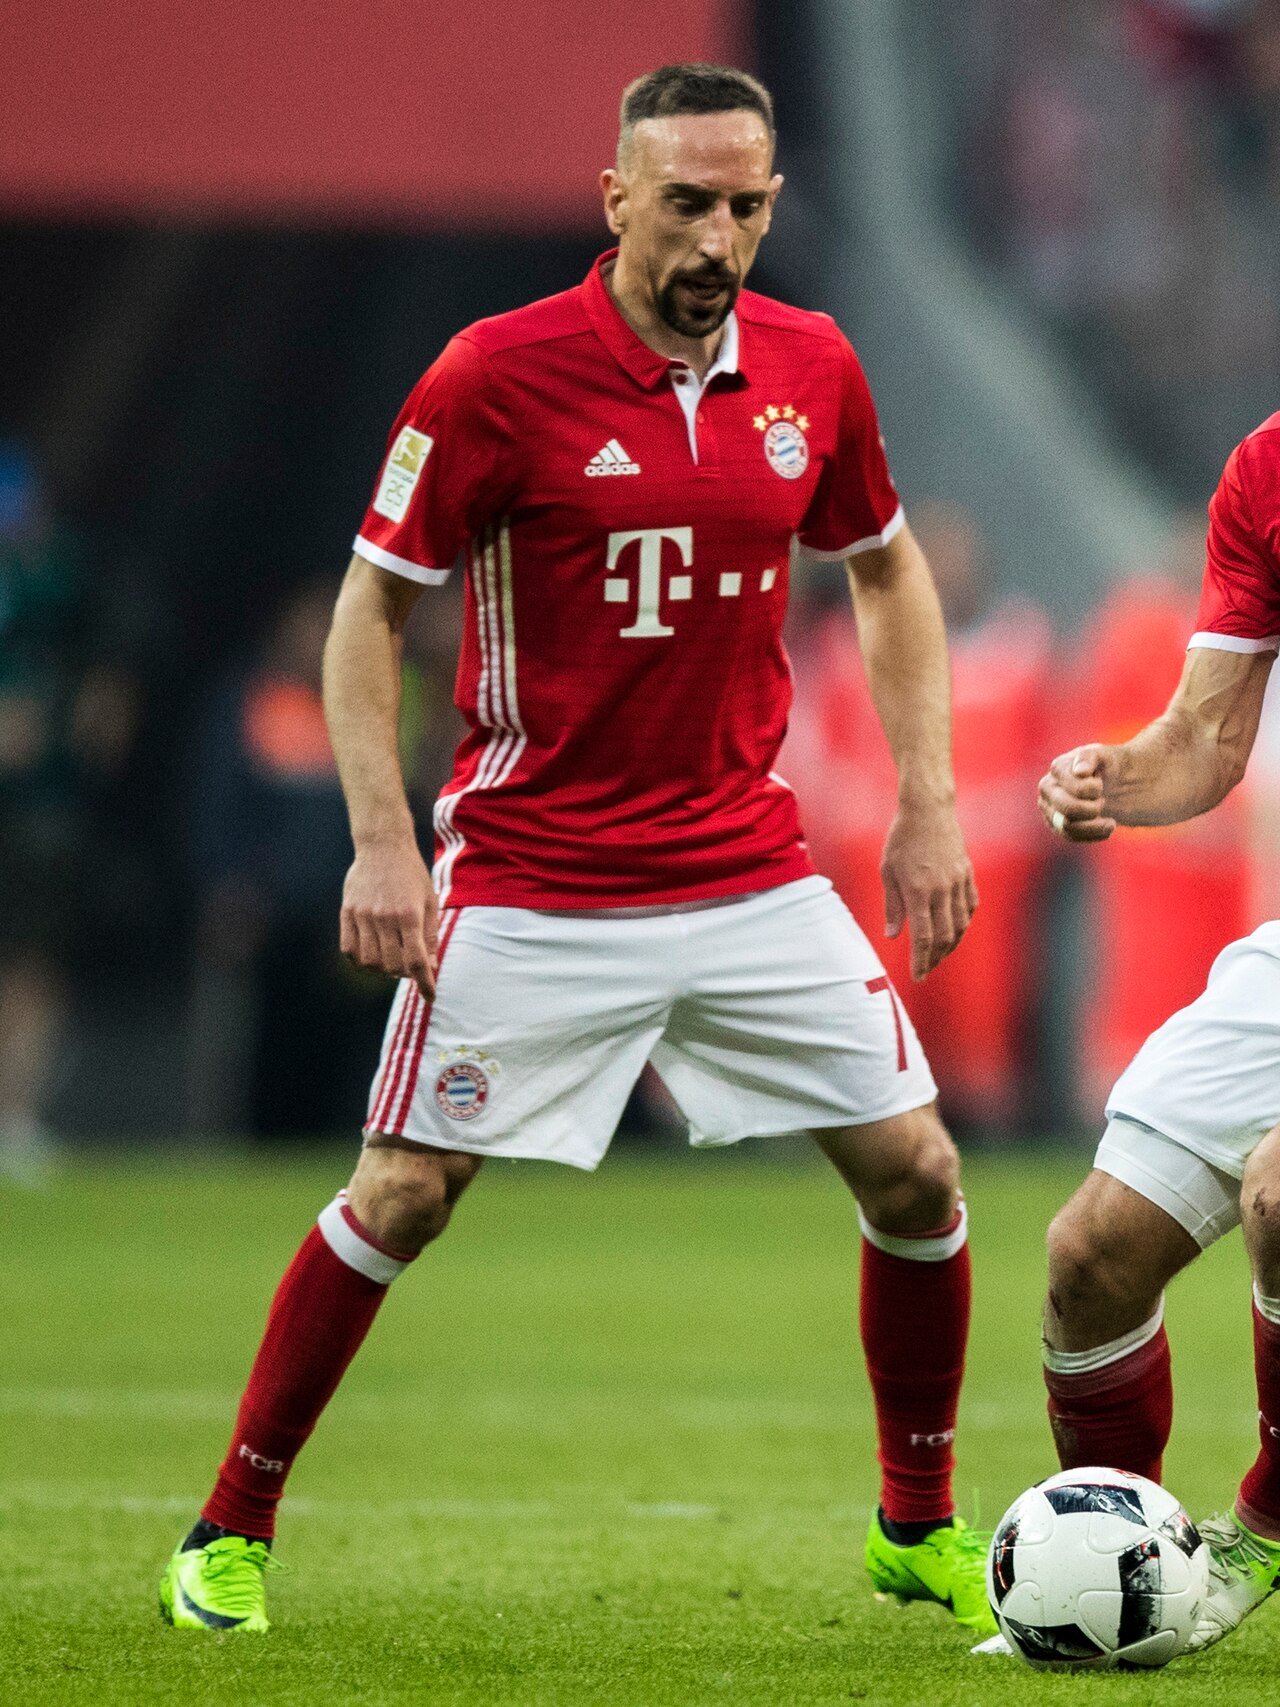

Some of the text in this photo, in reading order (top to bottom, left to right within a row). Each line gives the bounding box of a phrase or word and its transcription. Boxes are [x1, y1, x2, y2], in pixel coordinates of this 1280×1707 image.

[584, 463, 641, 477] adidas
[864, 975, 908, 1073] 7
[239, 1444, 284, 1473] FCB
